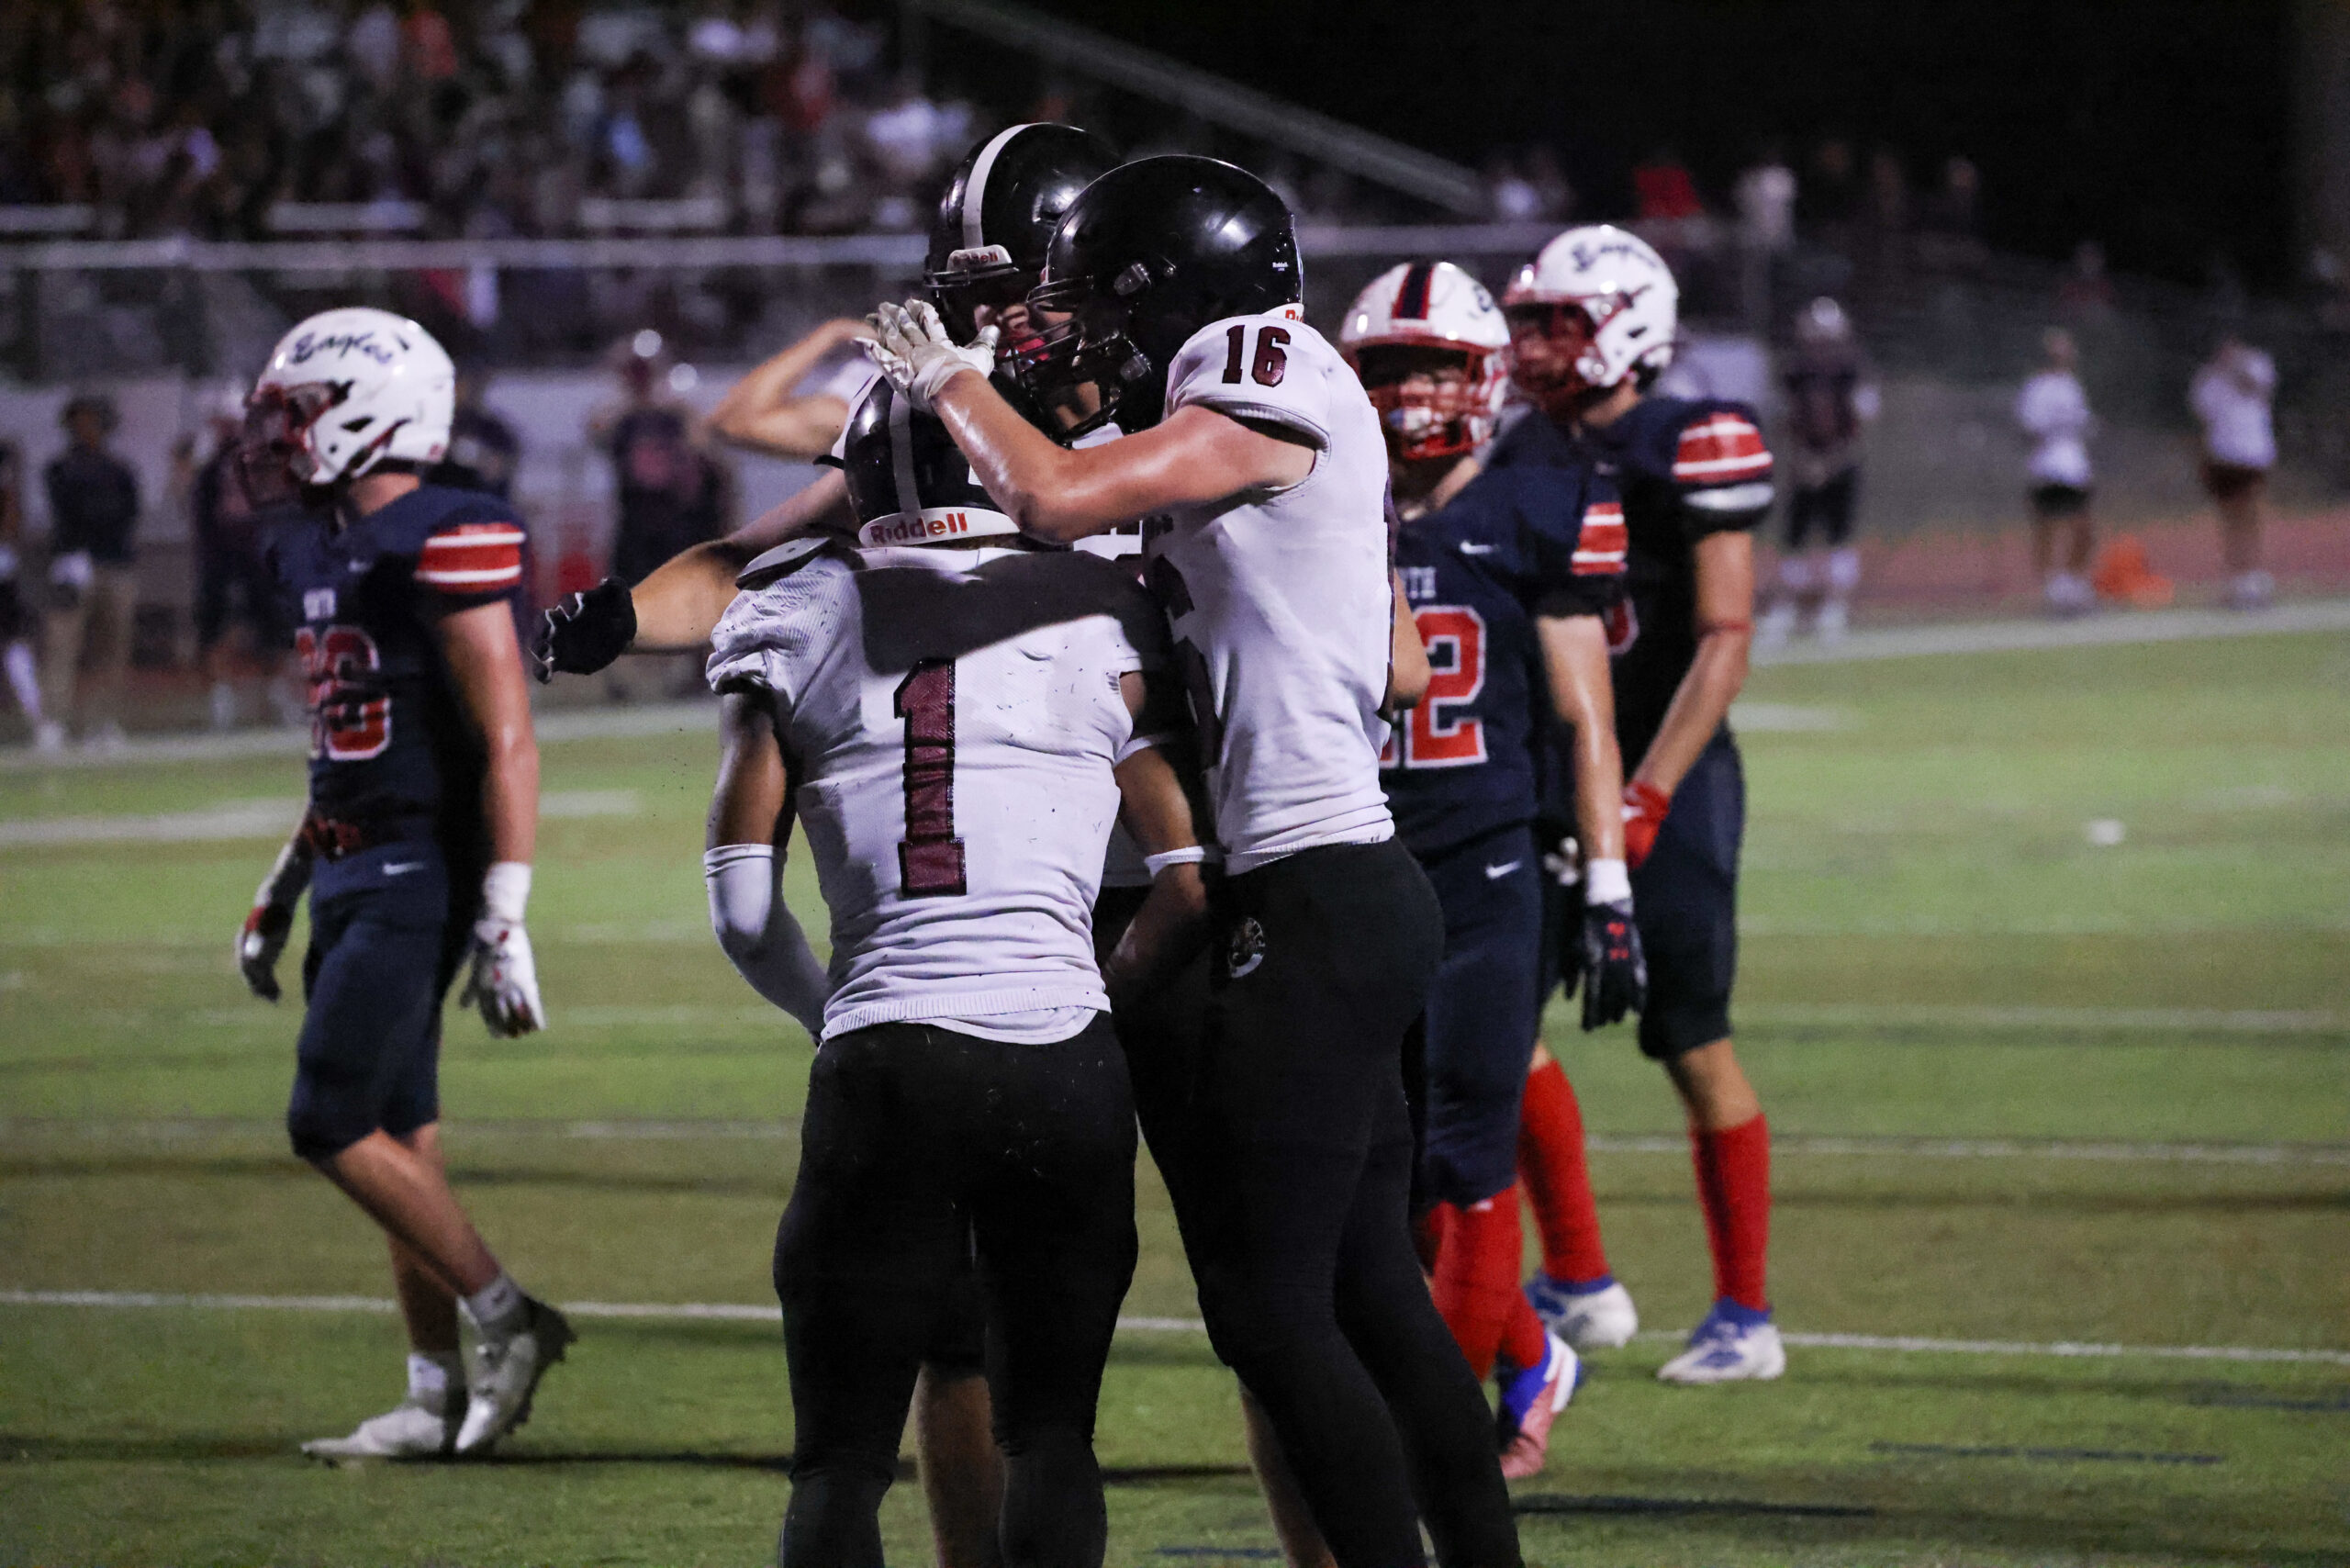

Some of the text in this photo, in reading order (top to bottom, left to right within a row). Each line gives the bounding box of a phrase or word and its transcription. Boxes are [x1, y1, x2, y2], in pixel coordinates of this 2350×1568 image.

[1222, 324, 1292, 388] 16
[868, 512, 968, 544] Riddell
[1380, 604, 1489, 769] 2
[893, 657, 968, 896] 1
